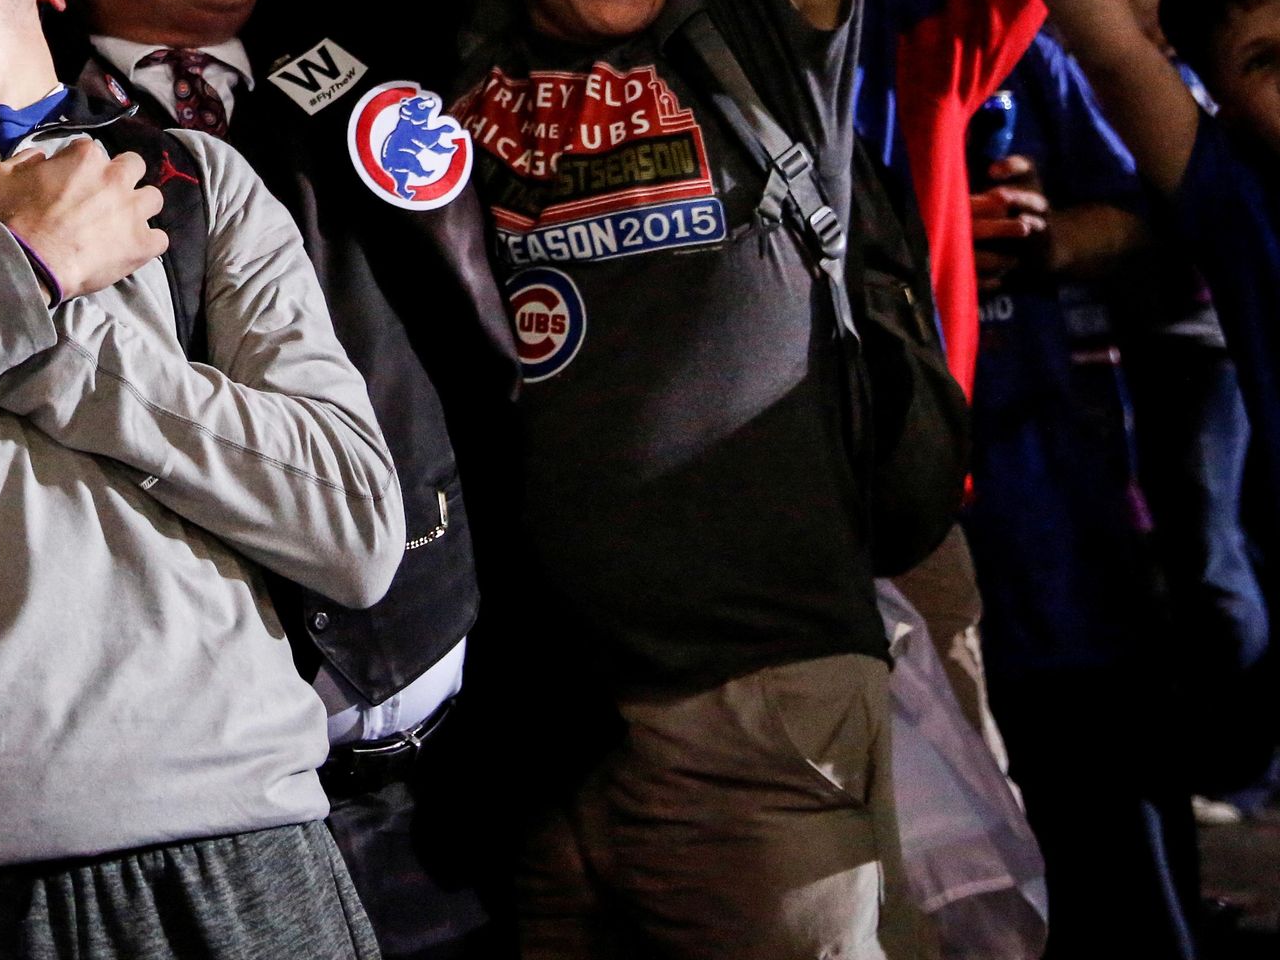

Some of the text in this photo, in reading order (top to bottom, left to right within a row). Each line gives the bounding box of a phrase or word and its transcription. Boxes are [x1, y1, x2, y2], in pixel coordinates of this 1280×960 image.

[275, 44, 341, 93] W
[308, 66, 357, 107] #FlyTheW
[619, 205, 718, 248] 2015
